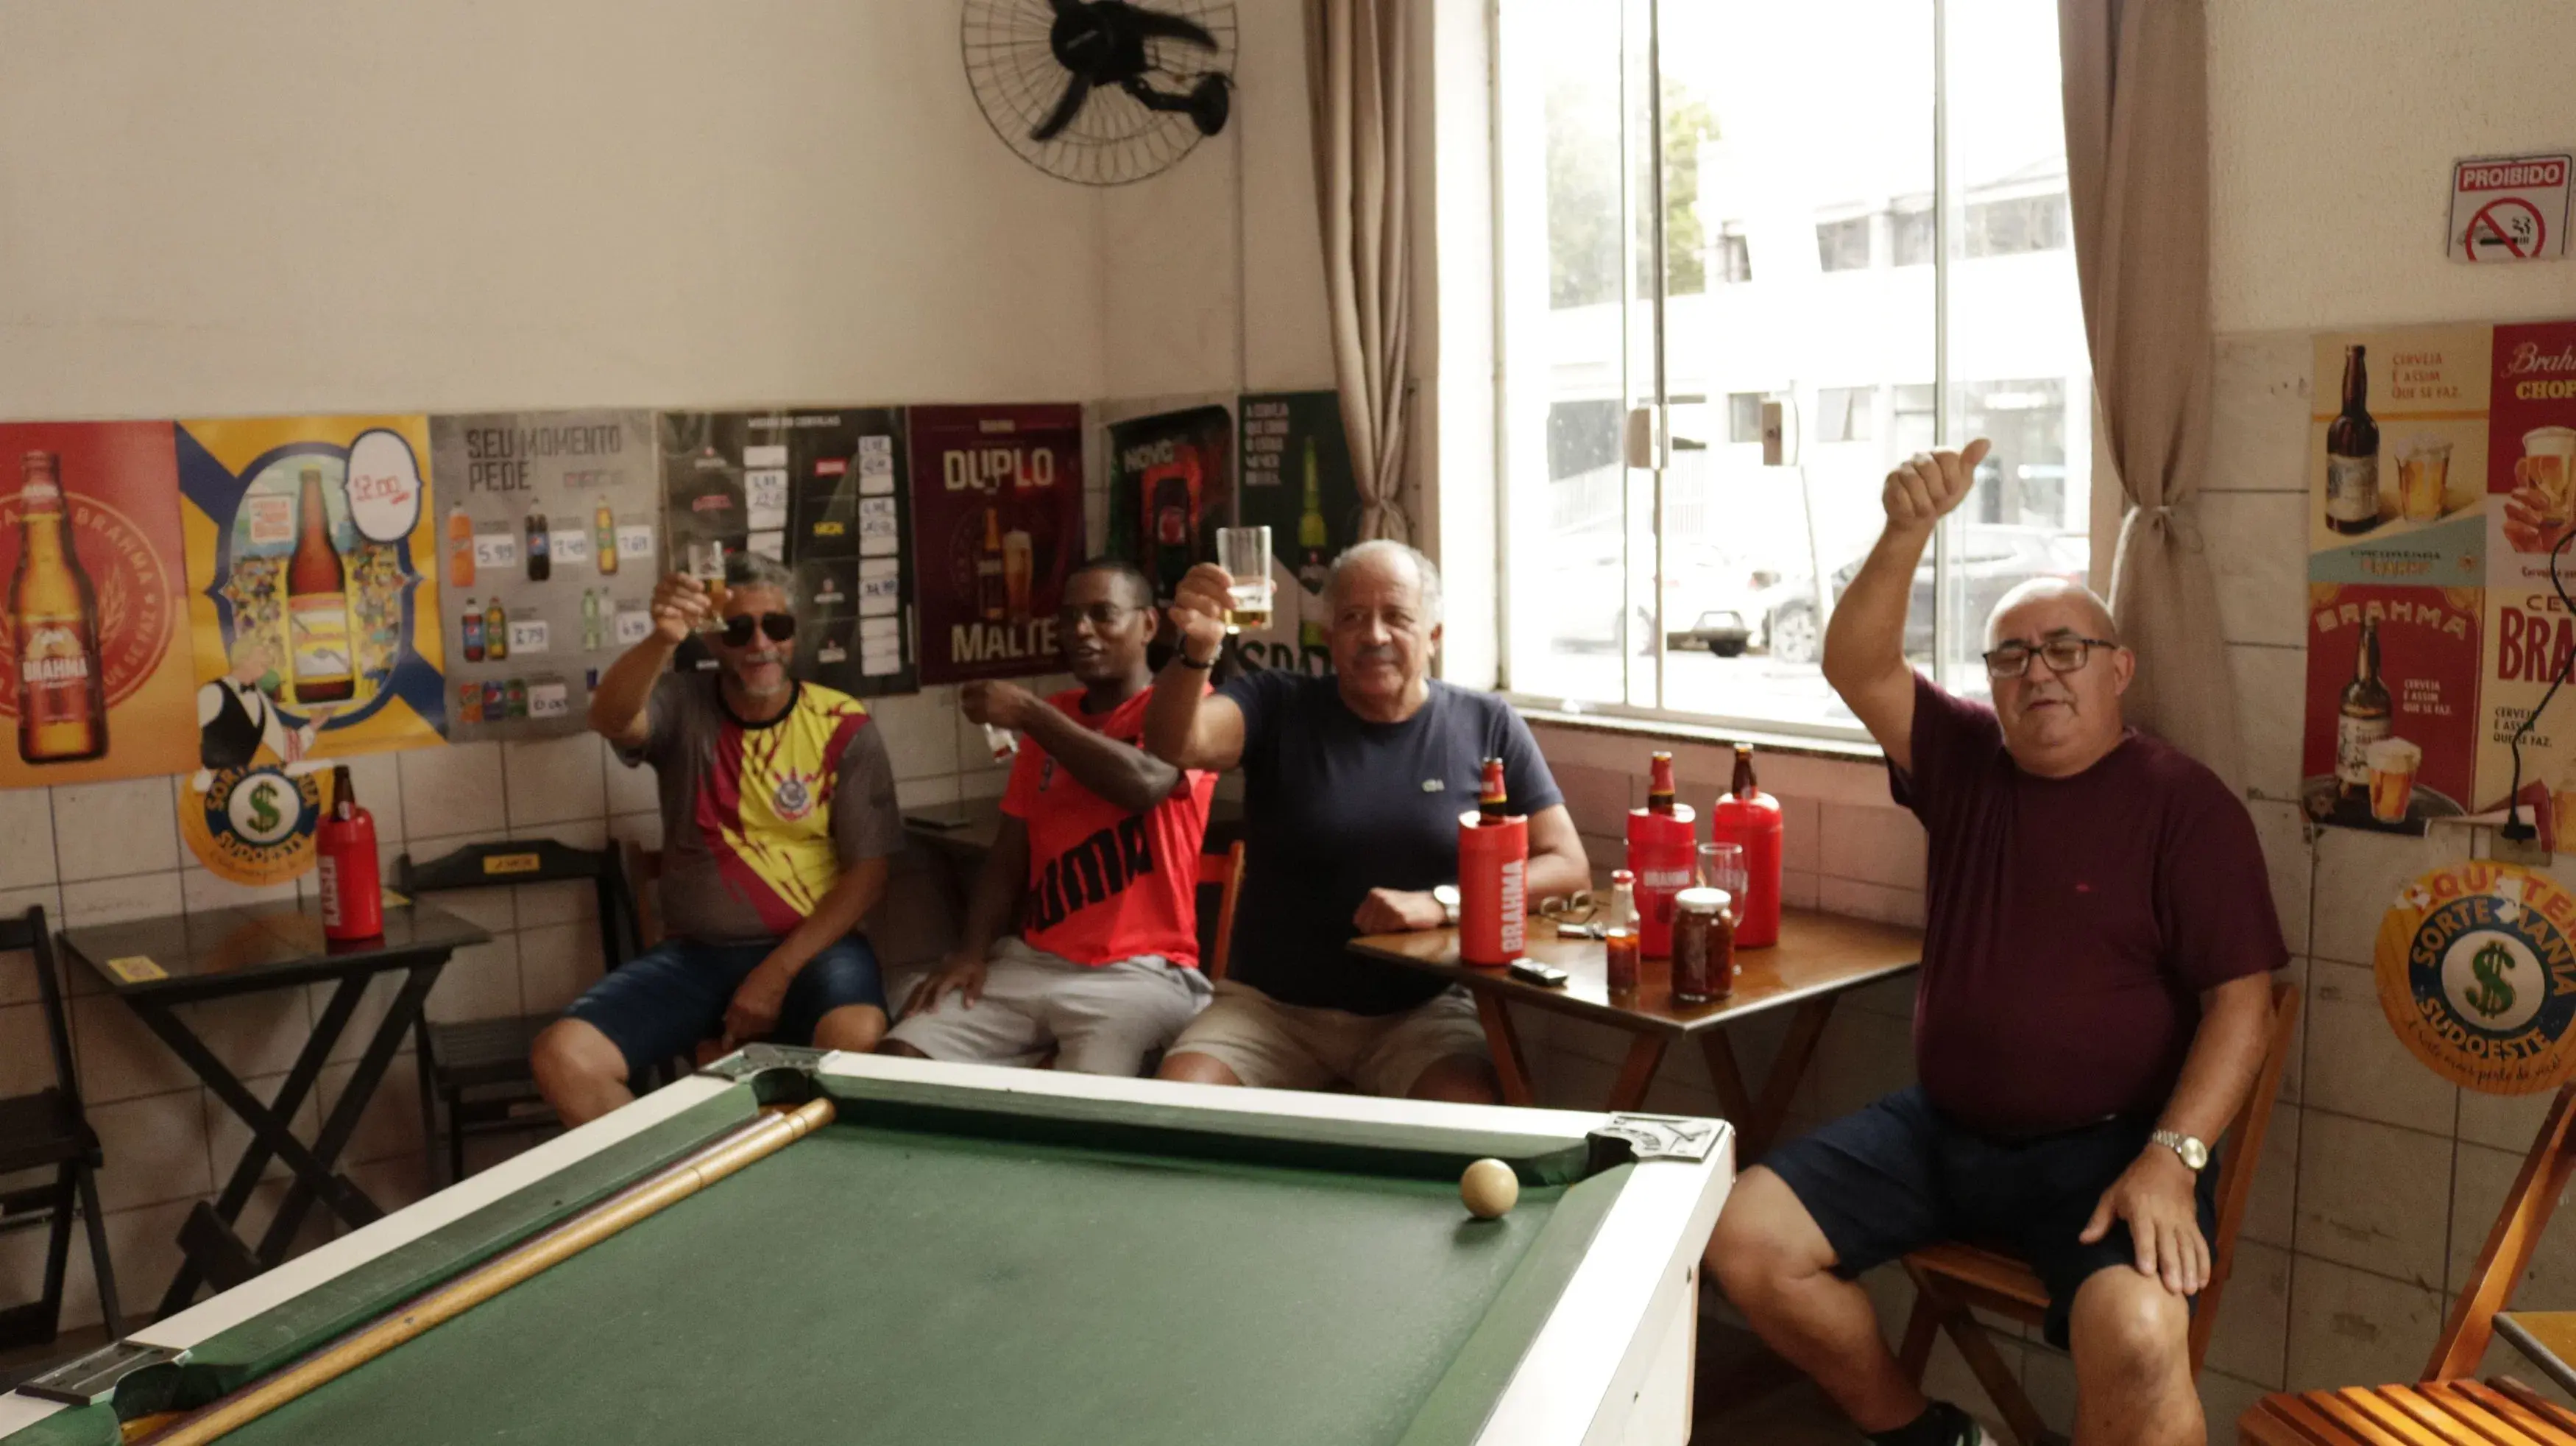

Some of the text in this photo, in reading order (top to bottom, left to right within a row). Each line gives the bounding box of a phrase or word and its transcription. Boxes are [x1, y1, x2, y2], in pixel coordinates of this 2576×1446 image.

[2463, 164, 2561, 188] PROIBIDO
[2391, 351, 2443, 366] CERVEJA
[2500, 342, 2576, 378] Brah
[467, 423, 621, 459] SEU MOMENTO
[468, 459, 532, 493] PEDE
[942, 446, 1055, 492] DUPLO
[76, 504, 154, 585] BRAHMA
[950, 613, 1061, 664] MALTE
[2317, 601, 2467, 641] BRAHMA
[23, 655, 88, 683] BRAHMA
[2404, 679, 2441, 691] CERVEJA
[2402, 702, 2420, 713] QUE
[2411, 691, 2440, 702] ASSIM
[1030, 813, 1155, 933] UMA
[1501, 859, 1526, 954] BRAHMA
[2418, 998, 2551, 1061] SUDOESTE
